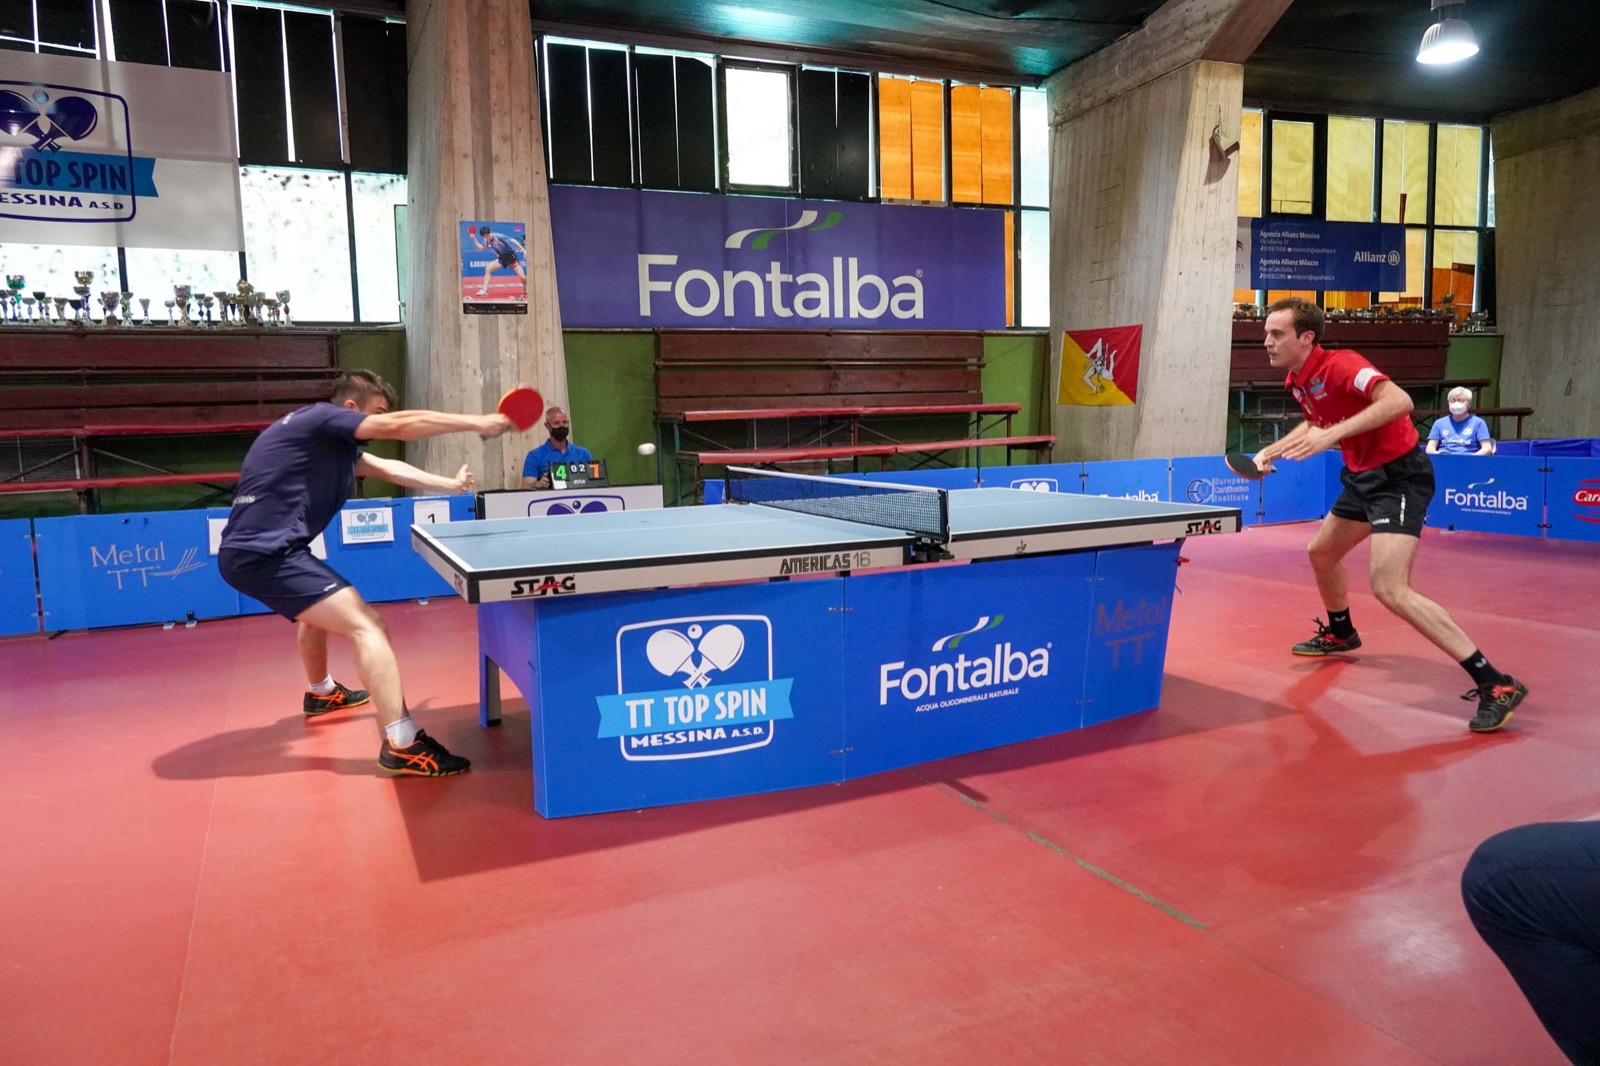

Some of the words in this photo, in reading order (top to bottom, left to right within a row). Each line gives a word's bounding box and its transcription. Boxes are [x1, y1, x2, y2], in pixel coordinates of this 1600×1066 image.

[67, 161, 127, 192] SPIN
[1260, 230, 1281, 239] Agenzia
[1259, 258, 1280, 266] Agenzia
[1281, 258, 1298, 266] Allianz
[1354, 251, 1386, 263] Allianz
[556, 465, 567, 480] 4
[570, 464, 577, 472] 0
[579, 464, 586, 472] 2
[1214, 494, 1249, 502] Institute
[1445, 488, 1528, 510] Fontalba
[427, 513, 435, 524] 1
[1185, 520, 1222, 534] STAG
[90, 540, 166, 568] Metal
[780, 554, 850, 574] AMERICAS
[853, 552, 870, 568] 16
[107, 566, 154, 590] TT
[510, 576, 576, 596] STAG
[880, 642, 1050, 706] Fontalba
[625, 698, 655, 729] TT
[664, 694, 710, 725] TOP
[714, 688, 766, 720] SPIN
[916, 703, 939, 712] ACQUA
[940, 693, 988, 708] OLIGOMINERALE
[989, 687, 1019, 699] NATURALE
[630, 727, 727, 748] MESSINA
[731, 726, 764, 738] A.S.D.
